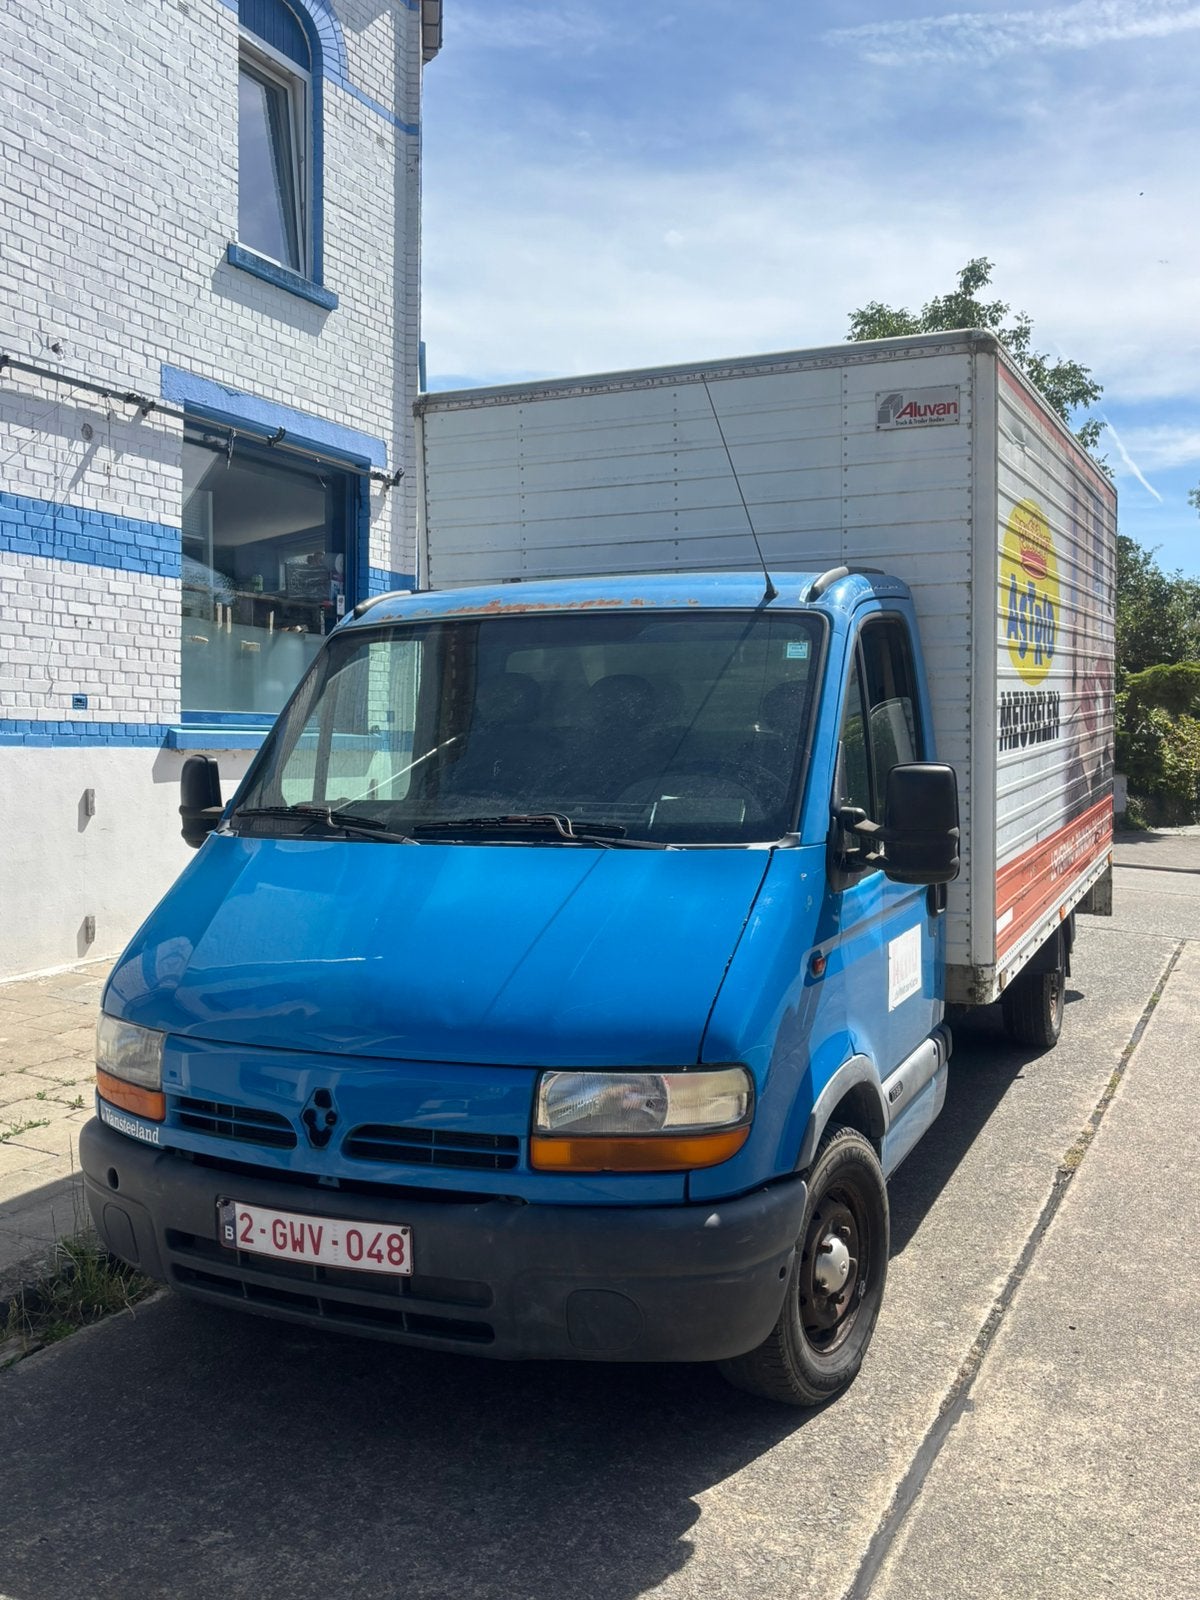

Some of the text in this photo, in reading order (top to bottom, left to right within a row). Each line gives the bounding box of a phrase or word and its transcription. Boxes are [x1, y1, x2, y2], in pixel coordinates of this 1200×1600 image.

[896, 401, 958, 419] Aluvan
[1006, 573, 1055, 666] ASTRID
[1000, 691, 1060, 752] MEUBELEN
[104, 1106, 160, 1145] Vansteeland
[224, 1212, 405, 1266] B 2-GWV-048
